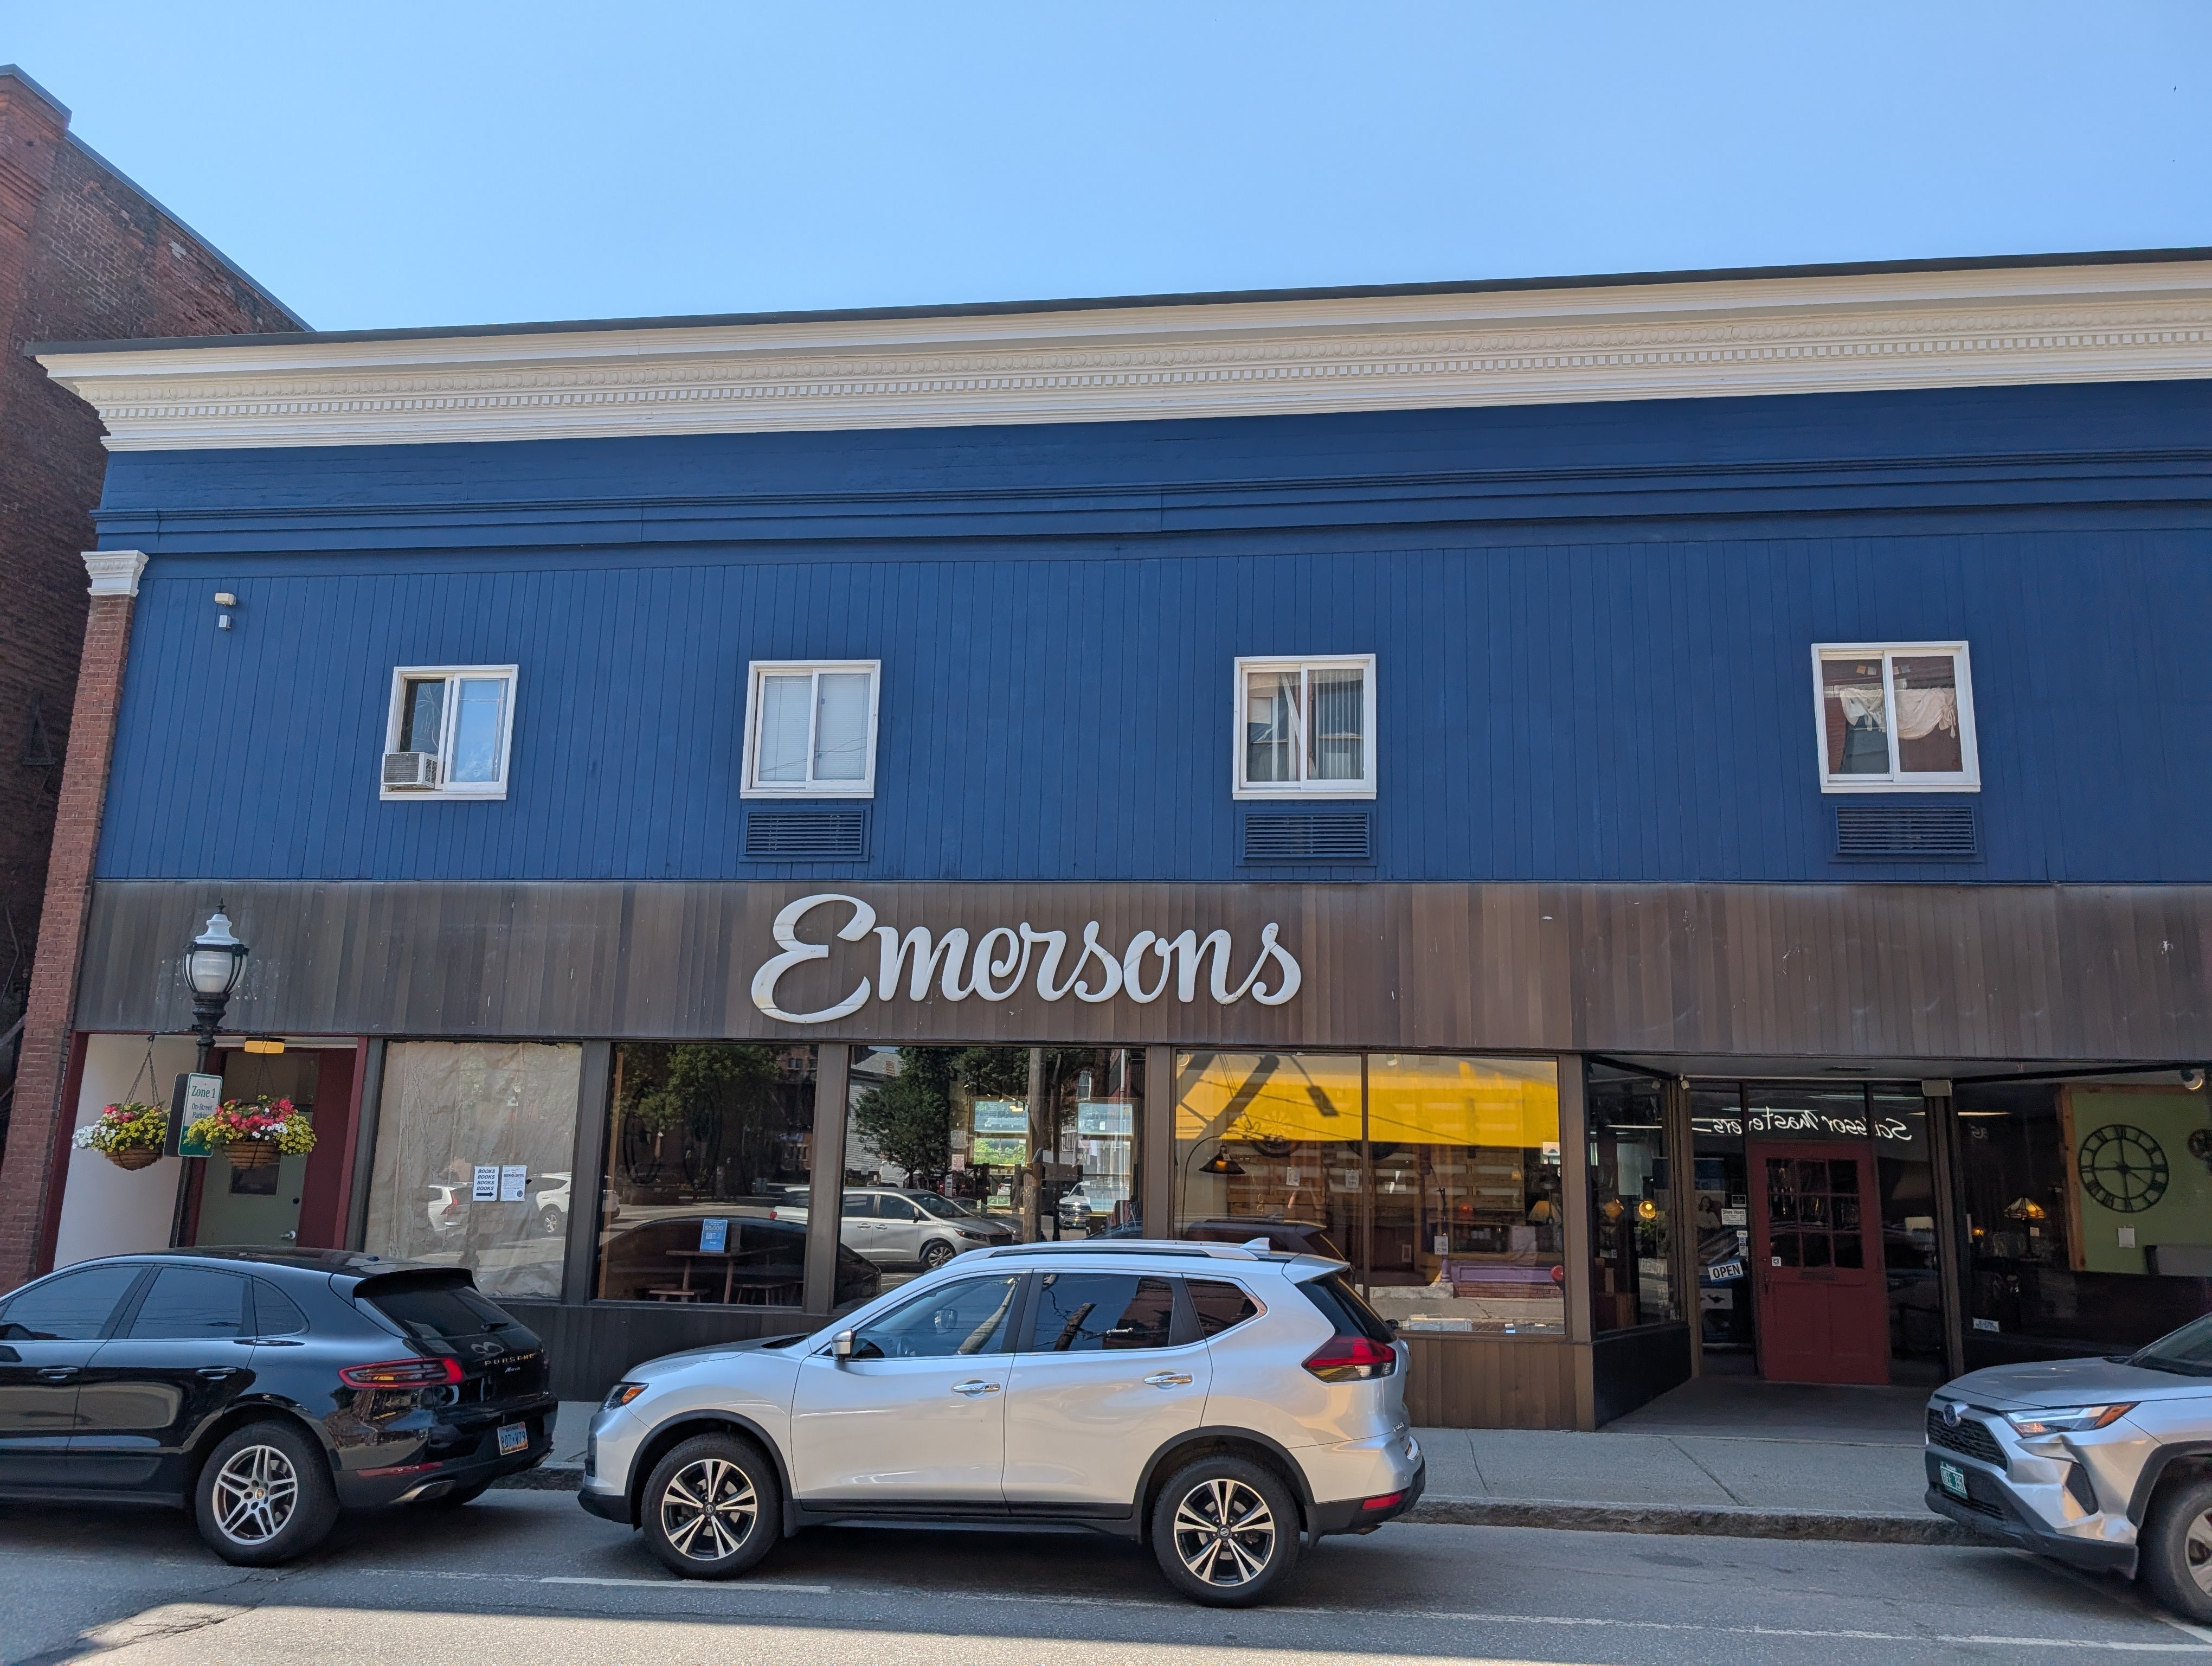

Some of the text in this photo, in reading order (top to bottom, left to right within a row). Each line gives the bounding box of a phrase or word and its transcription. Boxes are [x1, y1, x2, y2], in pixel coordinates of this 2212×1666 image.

[751, 894, 1302, 1023] Emersons
[191, 1085, 216, 1098] Zone 1
[191, 1103, 213, 1111] On-Street
[1712, 1264, 1741, 1279] OPEN
[485, 1354, 534, 1366] PORSCHE
